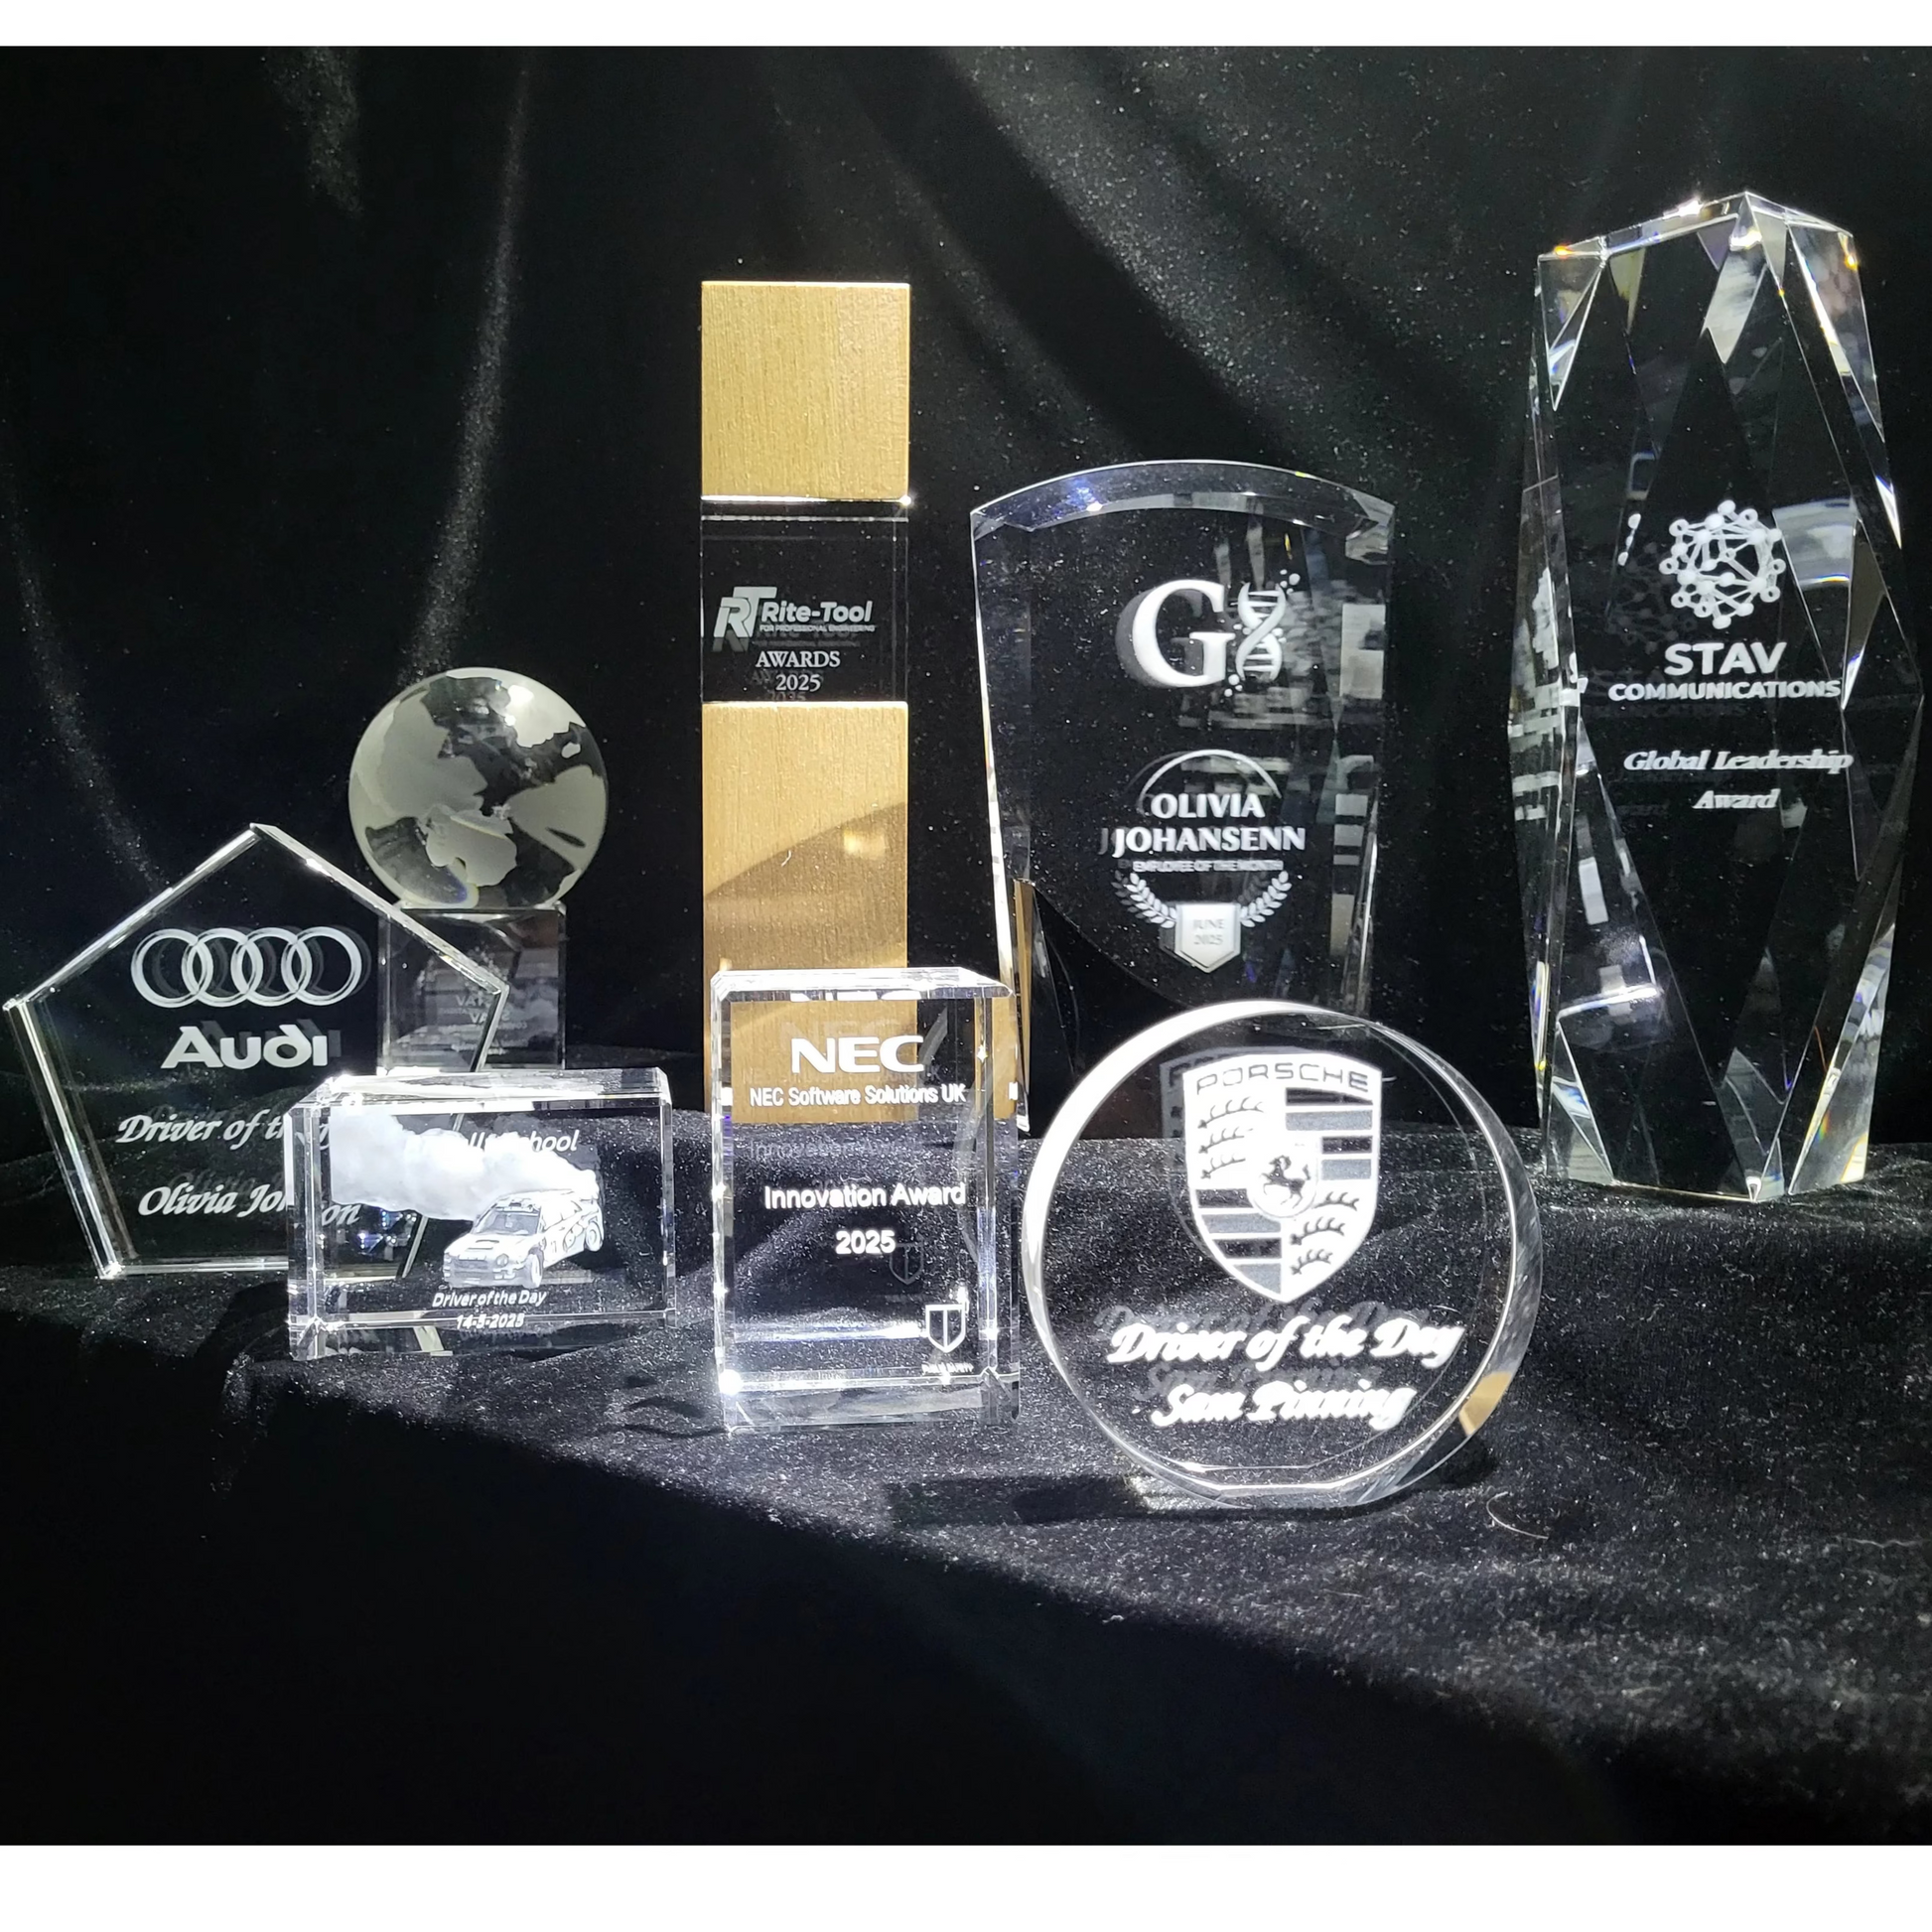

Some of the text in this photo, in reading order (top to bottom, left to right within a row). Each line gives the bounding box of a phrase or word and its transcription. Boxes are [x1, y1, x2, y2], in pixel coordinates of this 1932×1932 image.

[760, 600, 873, 622] Rite-Tool
[755, 650, 841, 668] AWARDS
[1664, 641, 1787, 676] STAV
[775, 674, 821, 691] 2025
[1607, 680, 1842, 701] COMMUNICATIONS
[1623, 749, 1855, 774] Global Leadership
[1150, 793, 1266, 819] OLIVIA
[1692, 788, 1781, 809] Award
[1112, 827, 1307, 859] JOHANSENN
[160, 1024, 328, 1069] Audi
[790, 1035, 925, 1073] NEC
[1195, 1062, 1369, 1095] PORSCHE
[750, 1083, 967, 1107] NEC Software Solutions UK
[115, 1113, 223, 1143] Driver
[223, 1109, 270, 1150] of
[138, 1181, 238, 1215] Olivia
[764, 1182, 966, 1209] Innovation Award
[835, 1230, 897, 1255] 2025
[432, 1290, 547, 1308] Driver of the Day
[1107, 1314, 1465, 1372] Driver of the Day
[1151, 1383, 1247, 1427] Sam
